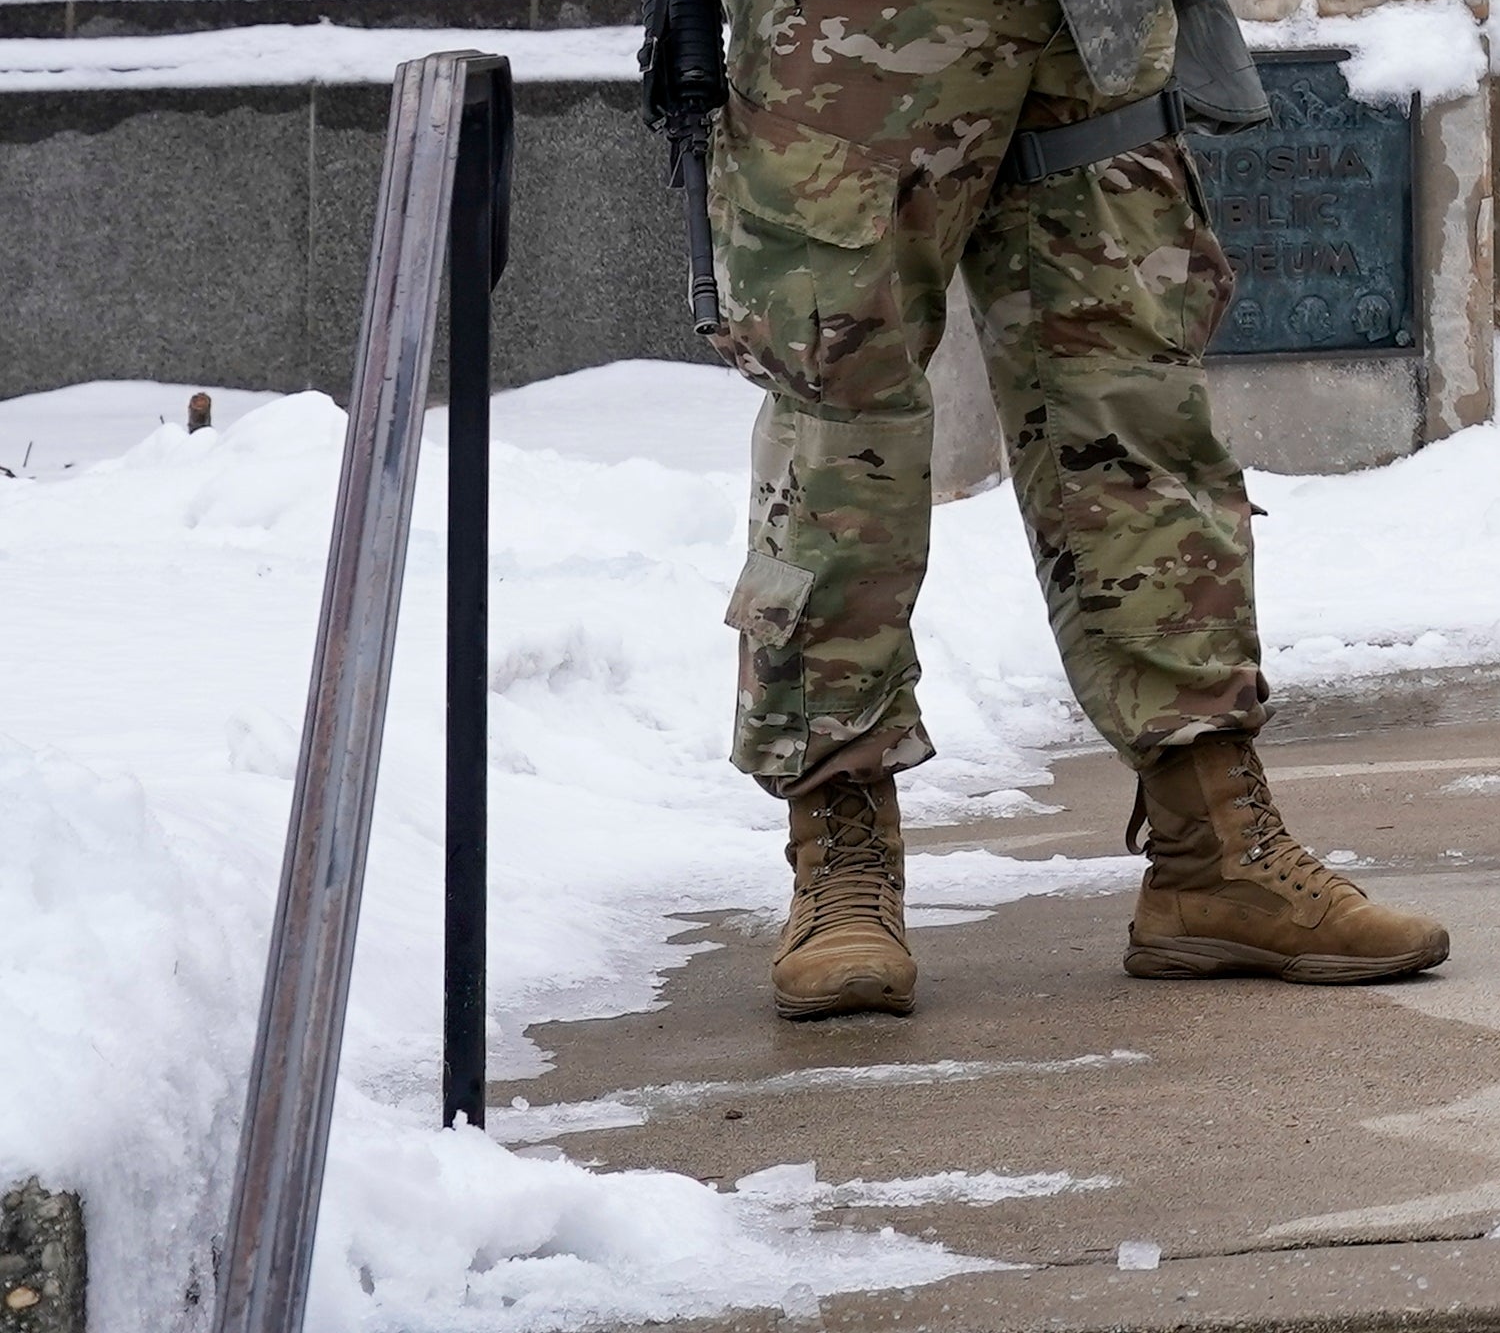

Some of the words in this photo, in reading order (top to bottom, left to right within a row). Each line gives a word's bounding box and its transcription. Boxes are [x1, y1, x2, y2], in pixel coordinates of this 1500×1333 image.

[1194, 144, 1372, 184] NOSHA
[1209, 192, 1341, 229] BLIC
[1222, 240, 1363, 278] SEUM
